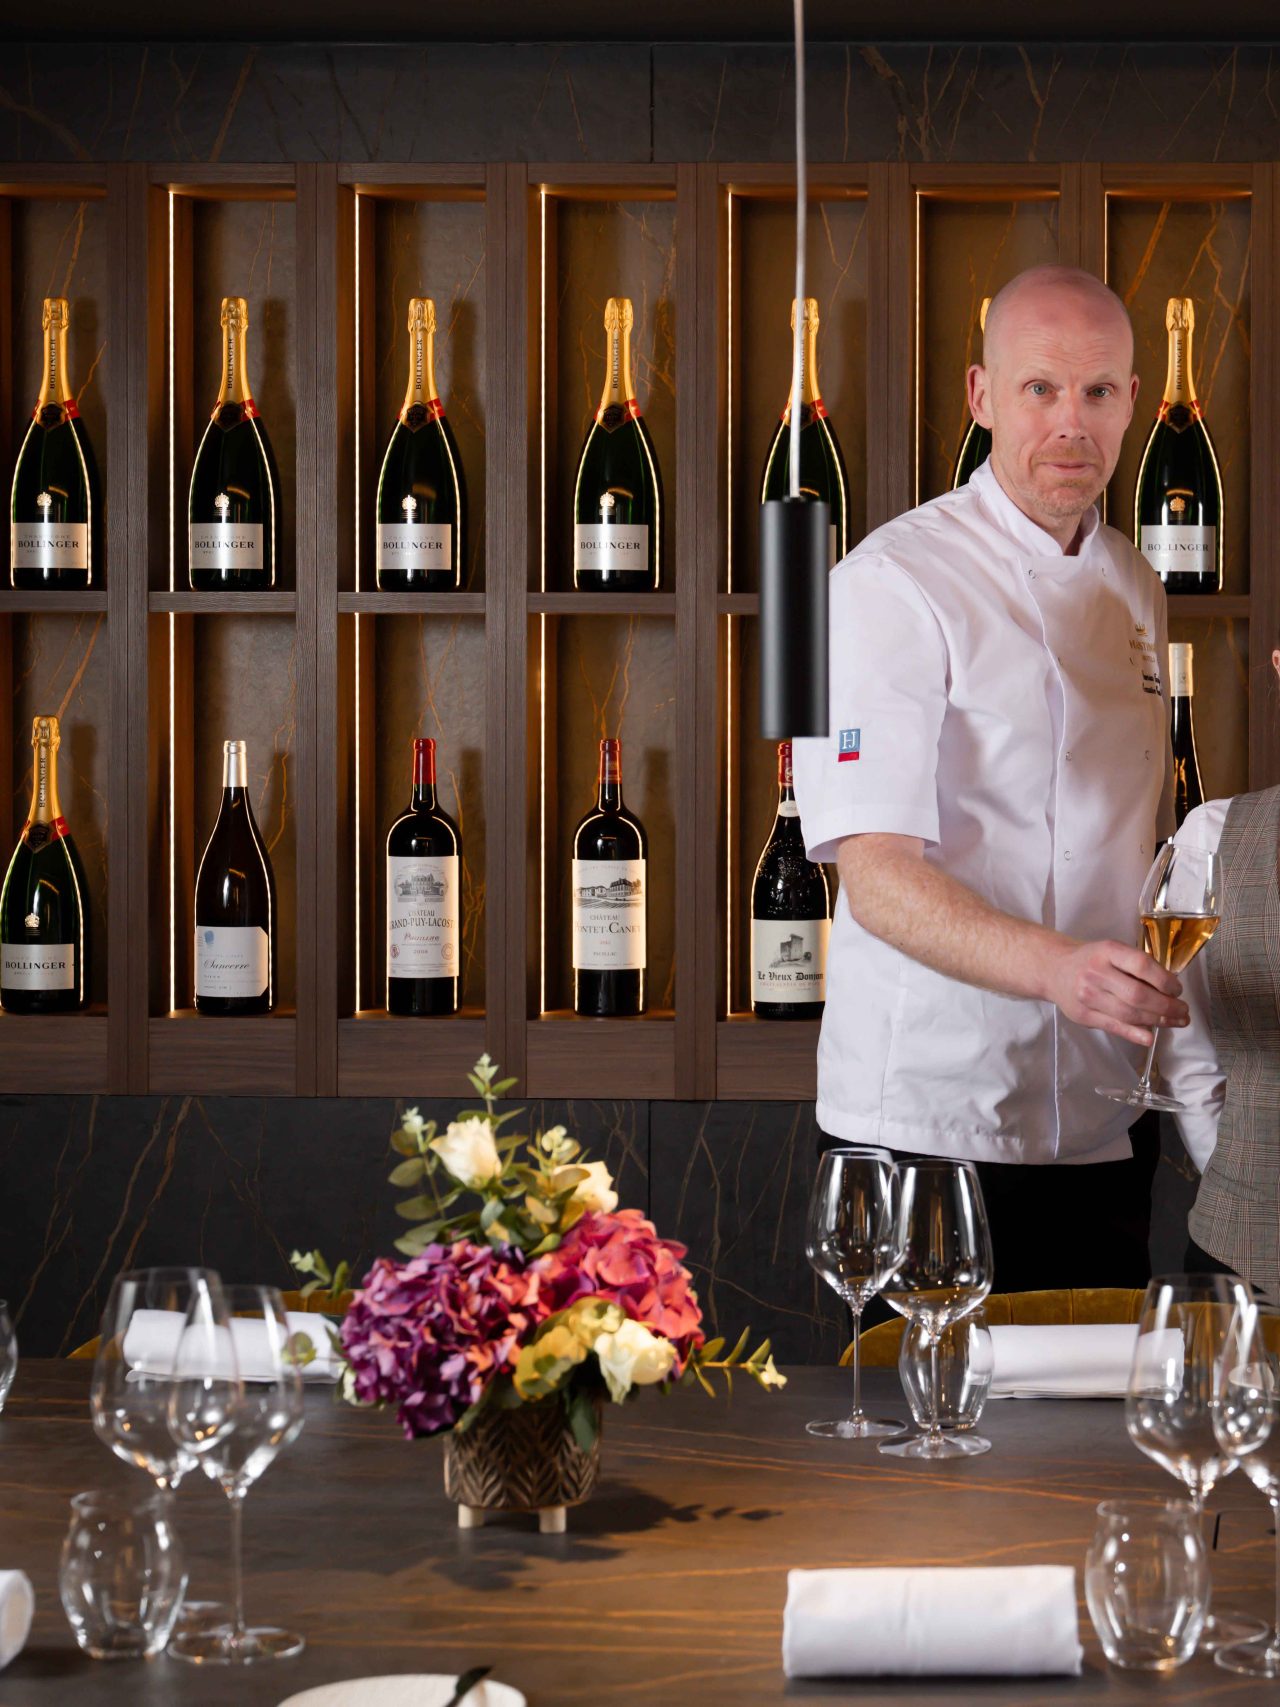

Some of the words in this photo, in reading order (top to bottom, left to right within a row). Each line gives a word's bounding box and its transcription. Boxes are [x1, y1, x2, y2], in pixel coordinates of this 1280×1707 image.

[18, 540, 79, 548] BOLLNGER
[194, 541, 255, 549] BOLLINGER
[1147, 543, 1209, 551] BOLINGER
[842, 731, 857, 749] HJ
[390, 917, 454, 930] RAND-PUY-LACOST
[5, 961, 66, 969] BOLLINGER
[757, 970, 766, 980] Le
[768, 971, 792, 981] Vieux
[795, 971, 824, 981] Donjon
